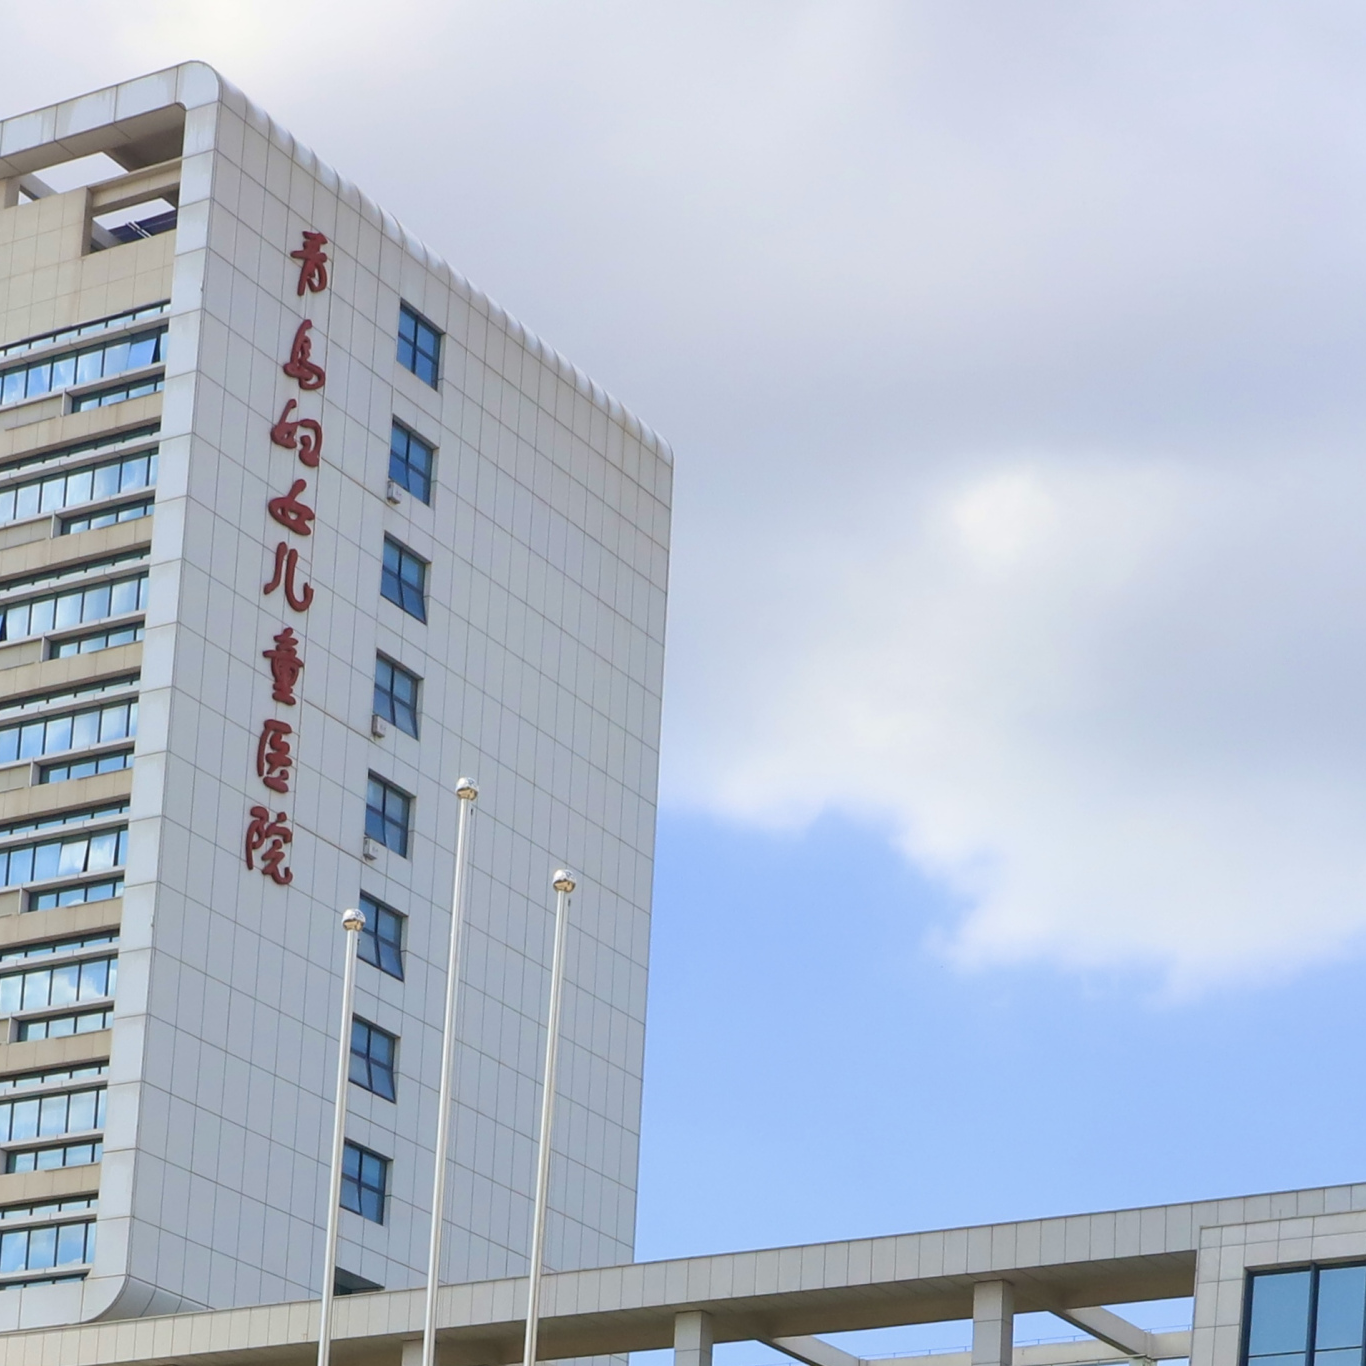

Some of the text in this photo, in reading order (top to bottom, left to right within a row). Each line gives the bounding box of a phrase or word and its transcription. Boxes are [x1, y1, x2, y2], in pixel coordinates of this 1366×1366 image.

[247, 231, 329, 885] 青岛妇女儿童医院
